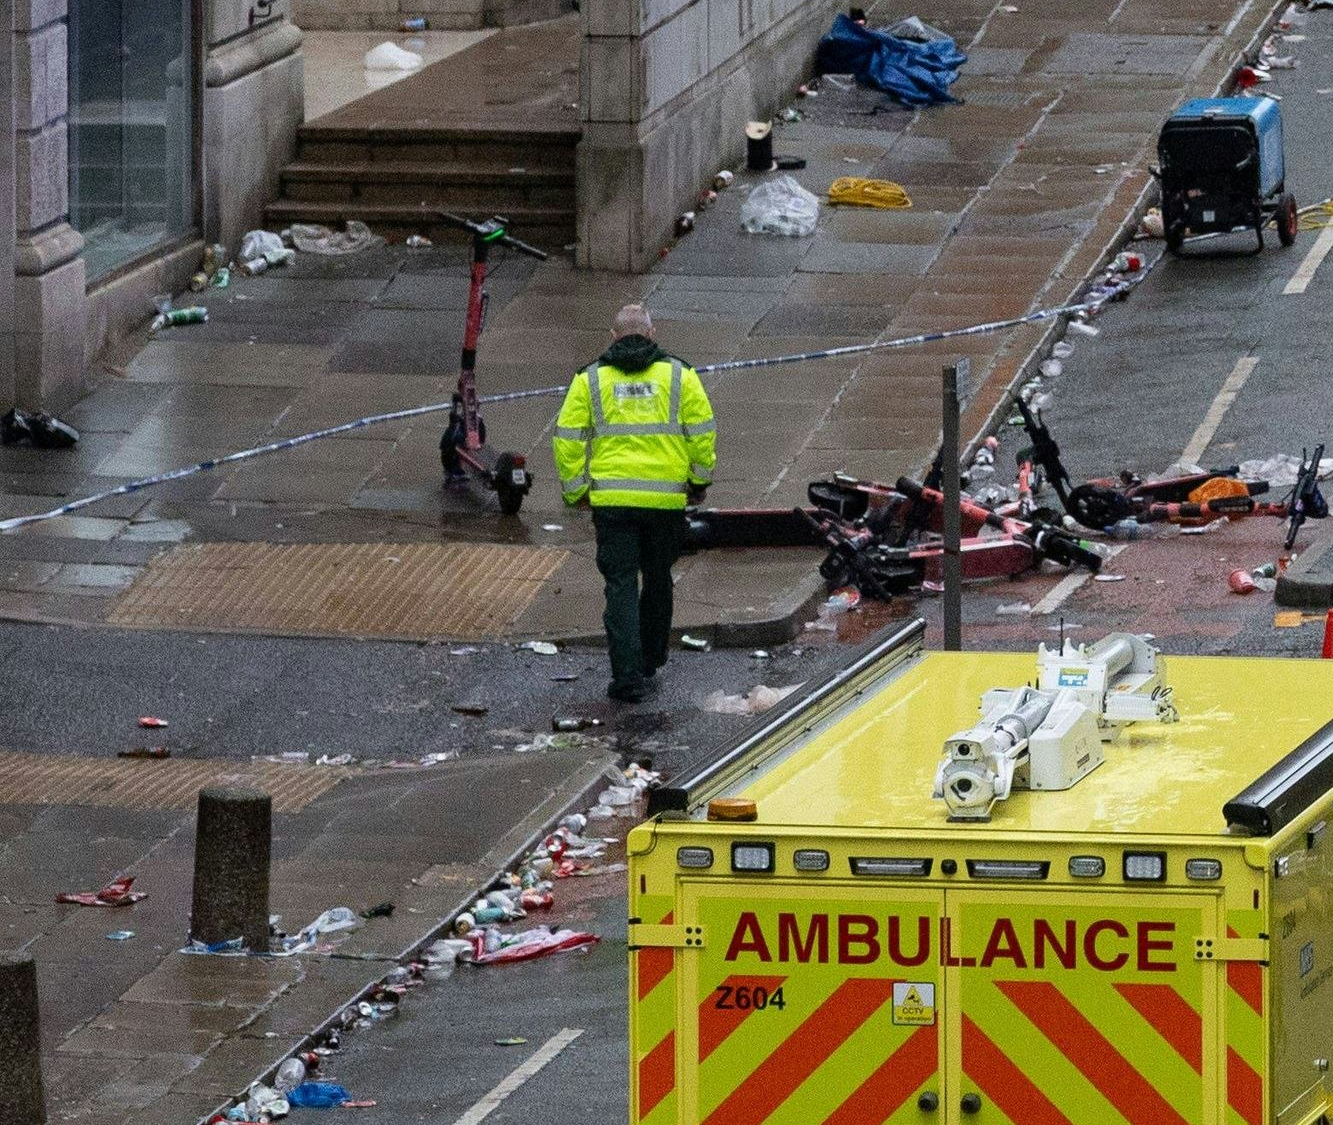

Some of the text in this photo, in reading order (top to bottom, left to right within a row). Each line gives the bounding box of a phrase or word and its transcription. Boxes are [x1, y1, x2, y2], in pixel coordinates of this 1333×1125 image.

[724, 911, 1177, 972] AMBULANCE
[715, 985, 786, 1012] Z604
[902, 1007, 924, 1015] CCTV
